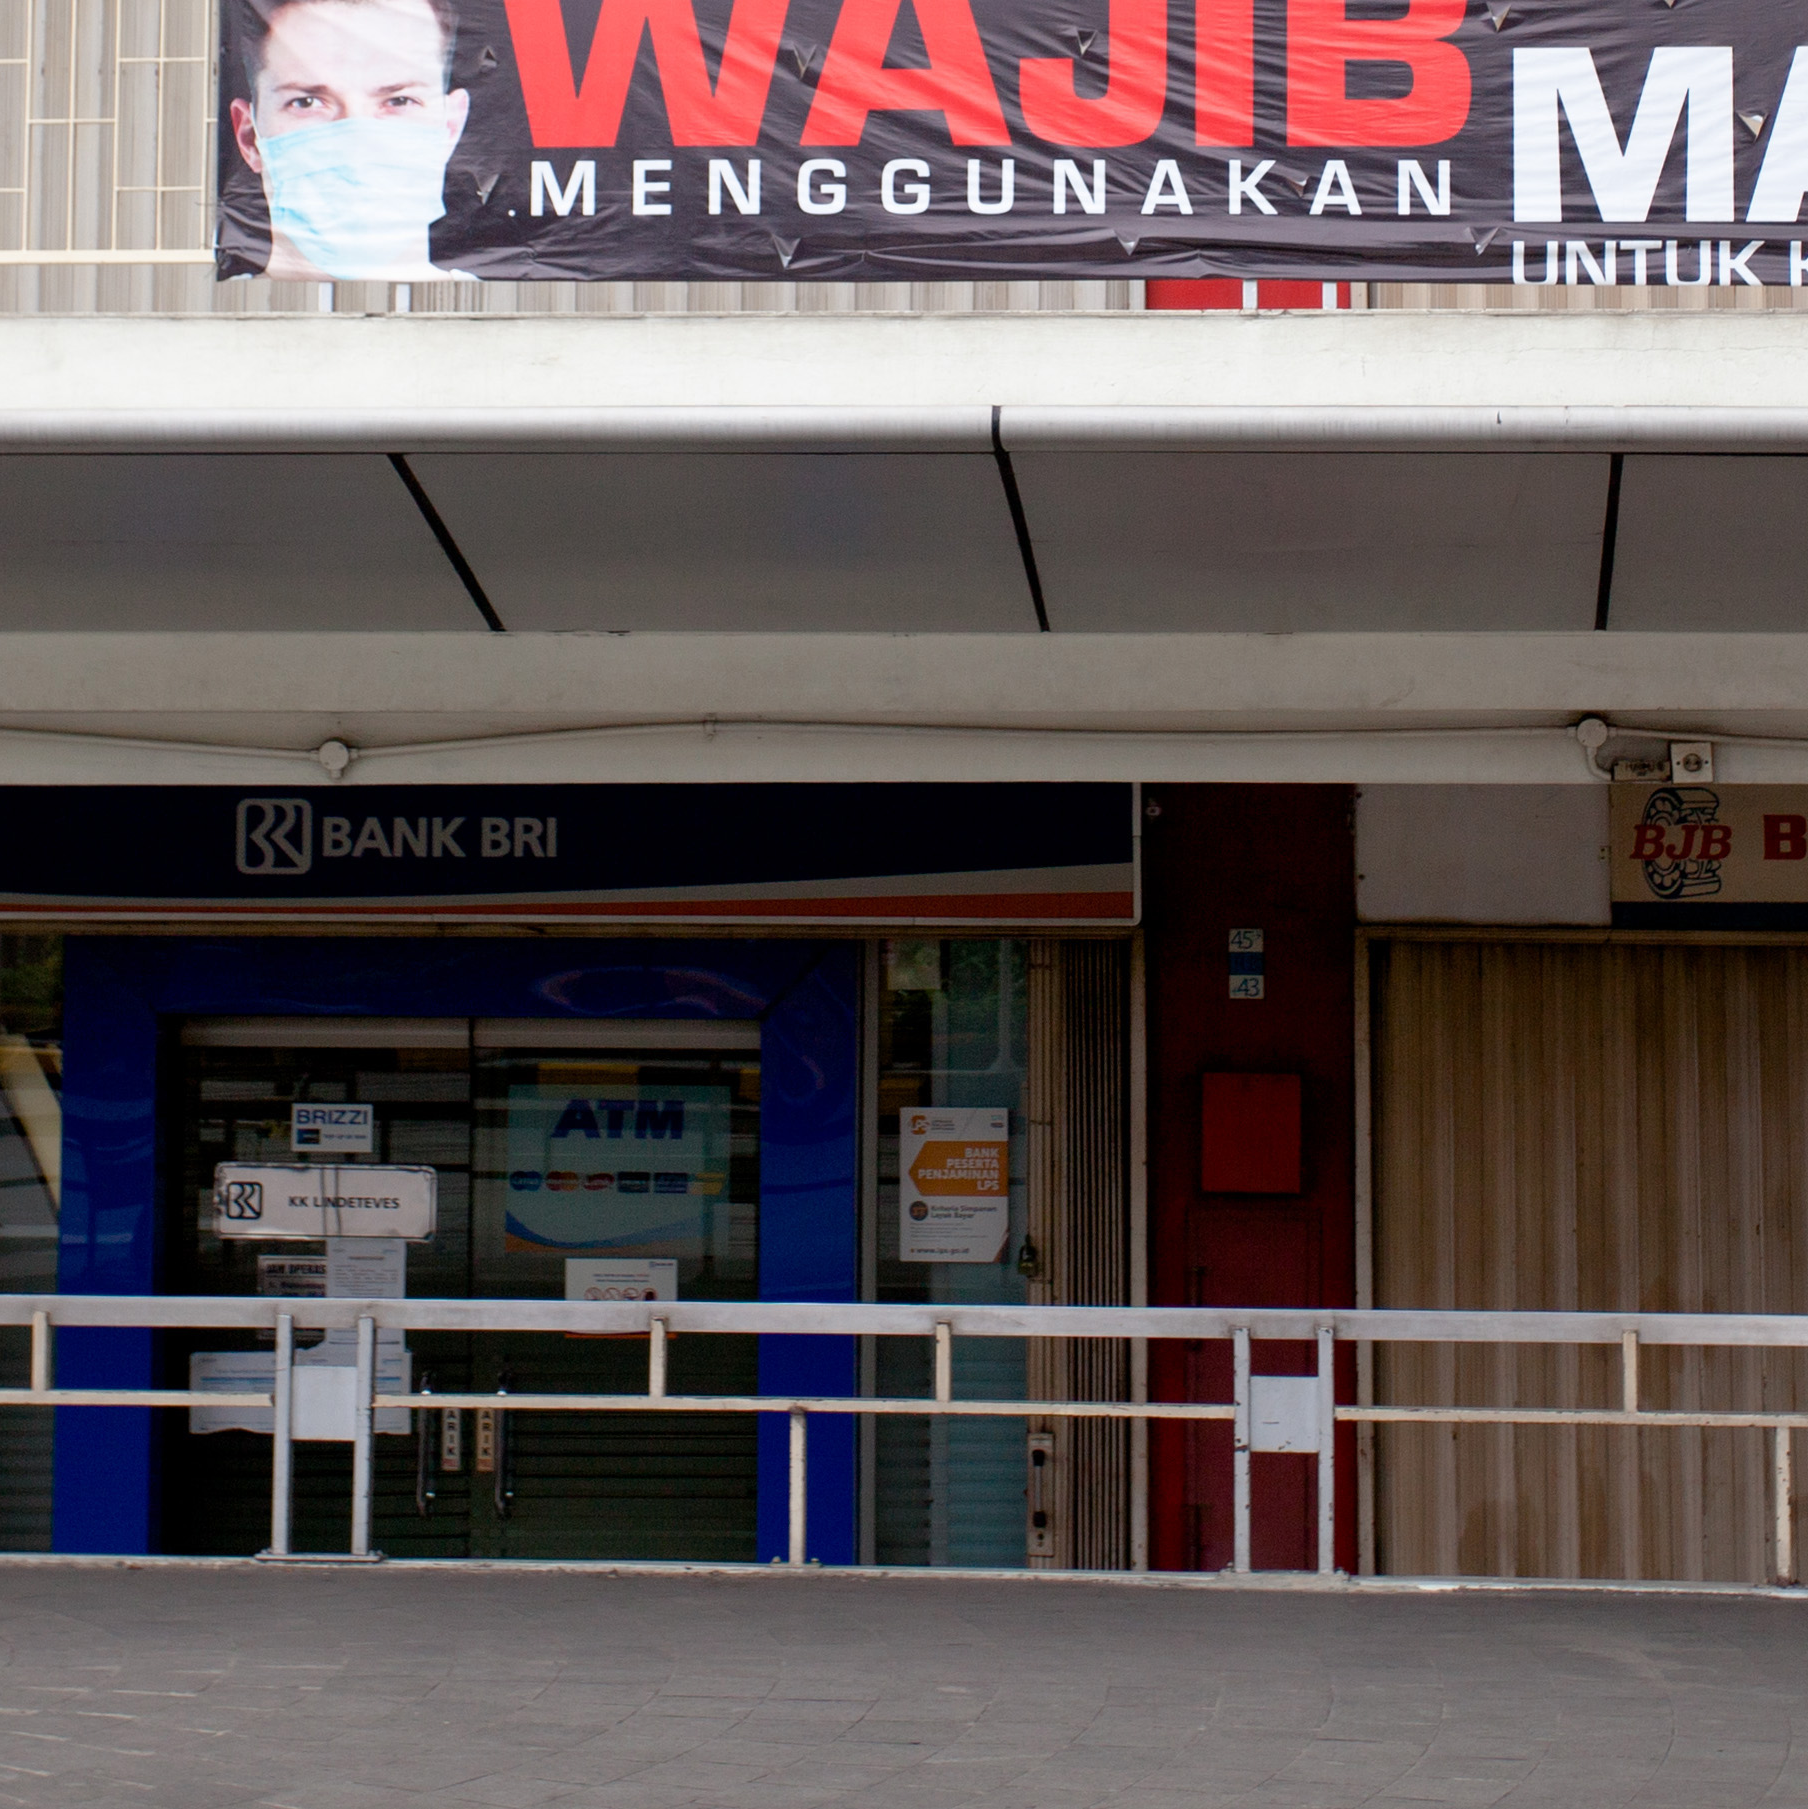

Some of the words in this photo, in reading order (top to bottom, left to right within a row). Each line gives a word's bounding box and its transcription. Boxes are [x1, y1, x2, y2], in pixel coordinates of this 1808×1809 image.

[530, 158, 1451, 217] MENGGUNAKAN
[1512, 239, 1766, 286] UNTUK
[321, 816, 467, 858] BANK
[480, 816, 558, 858] BRI
[1629, 824, 1732, 861] BJB
[1231, 930, 1254, 950] 45
[1237, 977, 1260, 997] 43
[296, 1109, 368, 1125] BRIZZI
[550, 1099, 685, 1139] ATM
[964, 1147, 1000, 1158] BANK
[946, 1158, 1000, 1169] PESERTA
[917, 1169, 1000, 1180] PENJAMINAN
[976, 1180, 1000, 1191] LPS
[288, 1196, 309, 1207] KK
[312, 1196, 401, 1210] LINDETEVES
[446, 1409, 457, 1457] ARIK
[481, 1409, 492, 1457] ARIK
